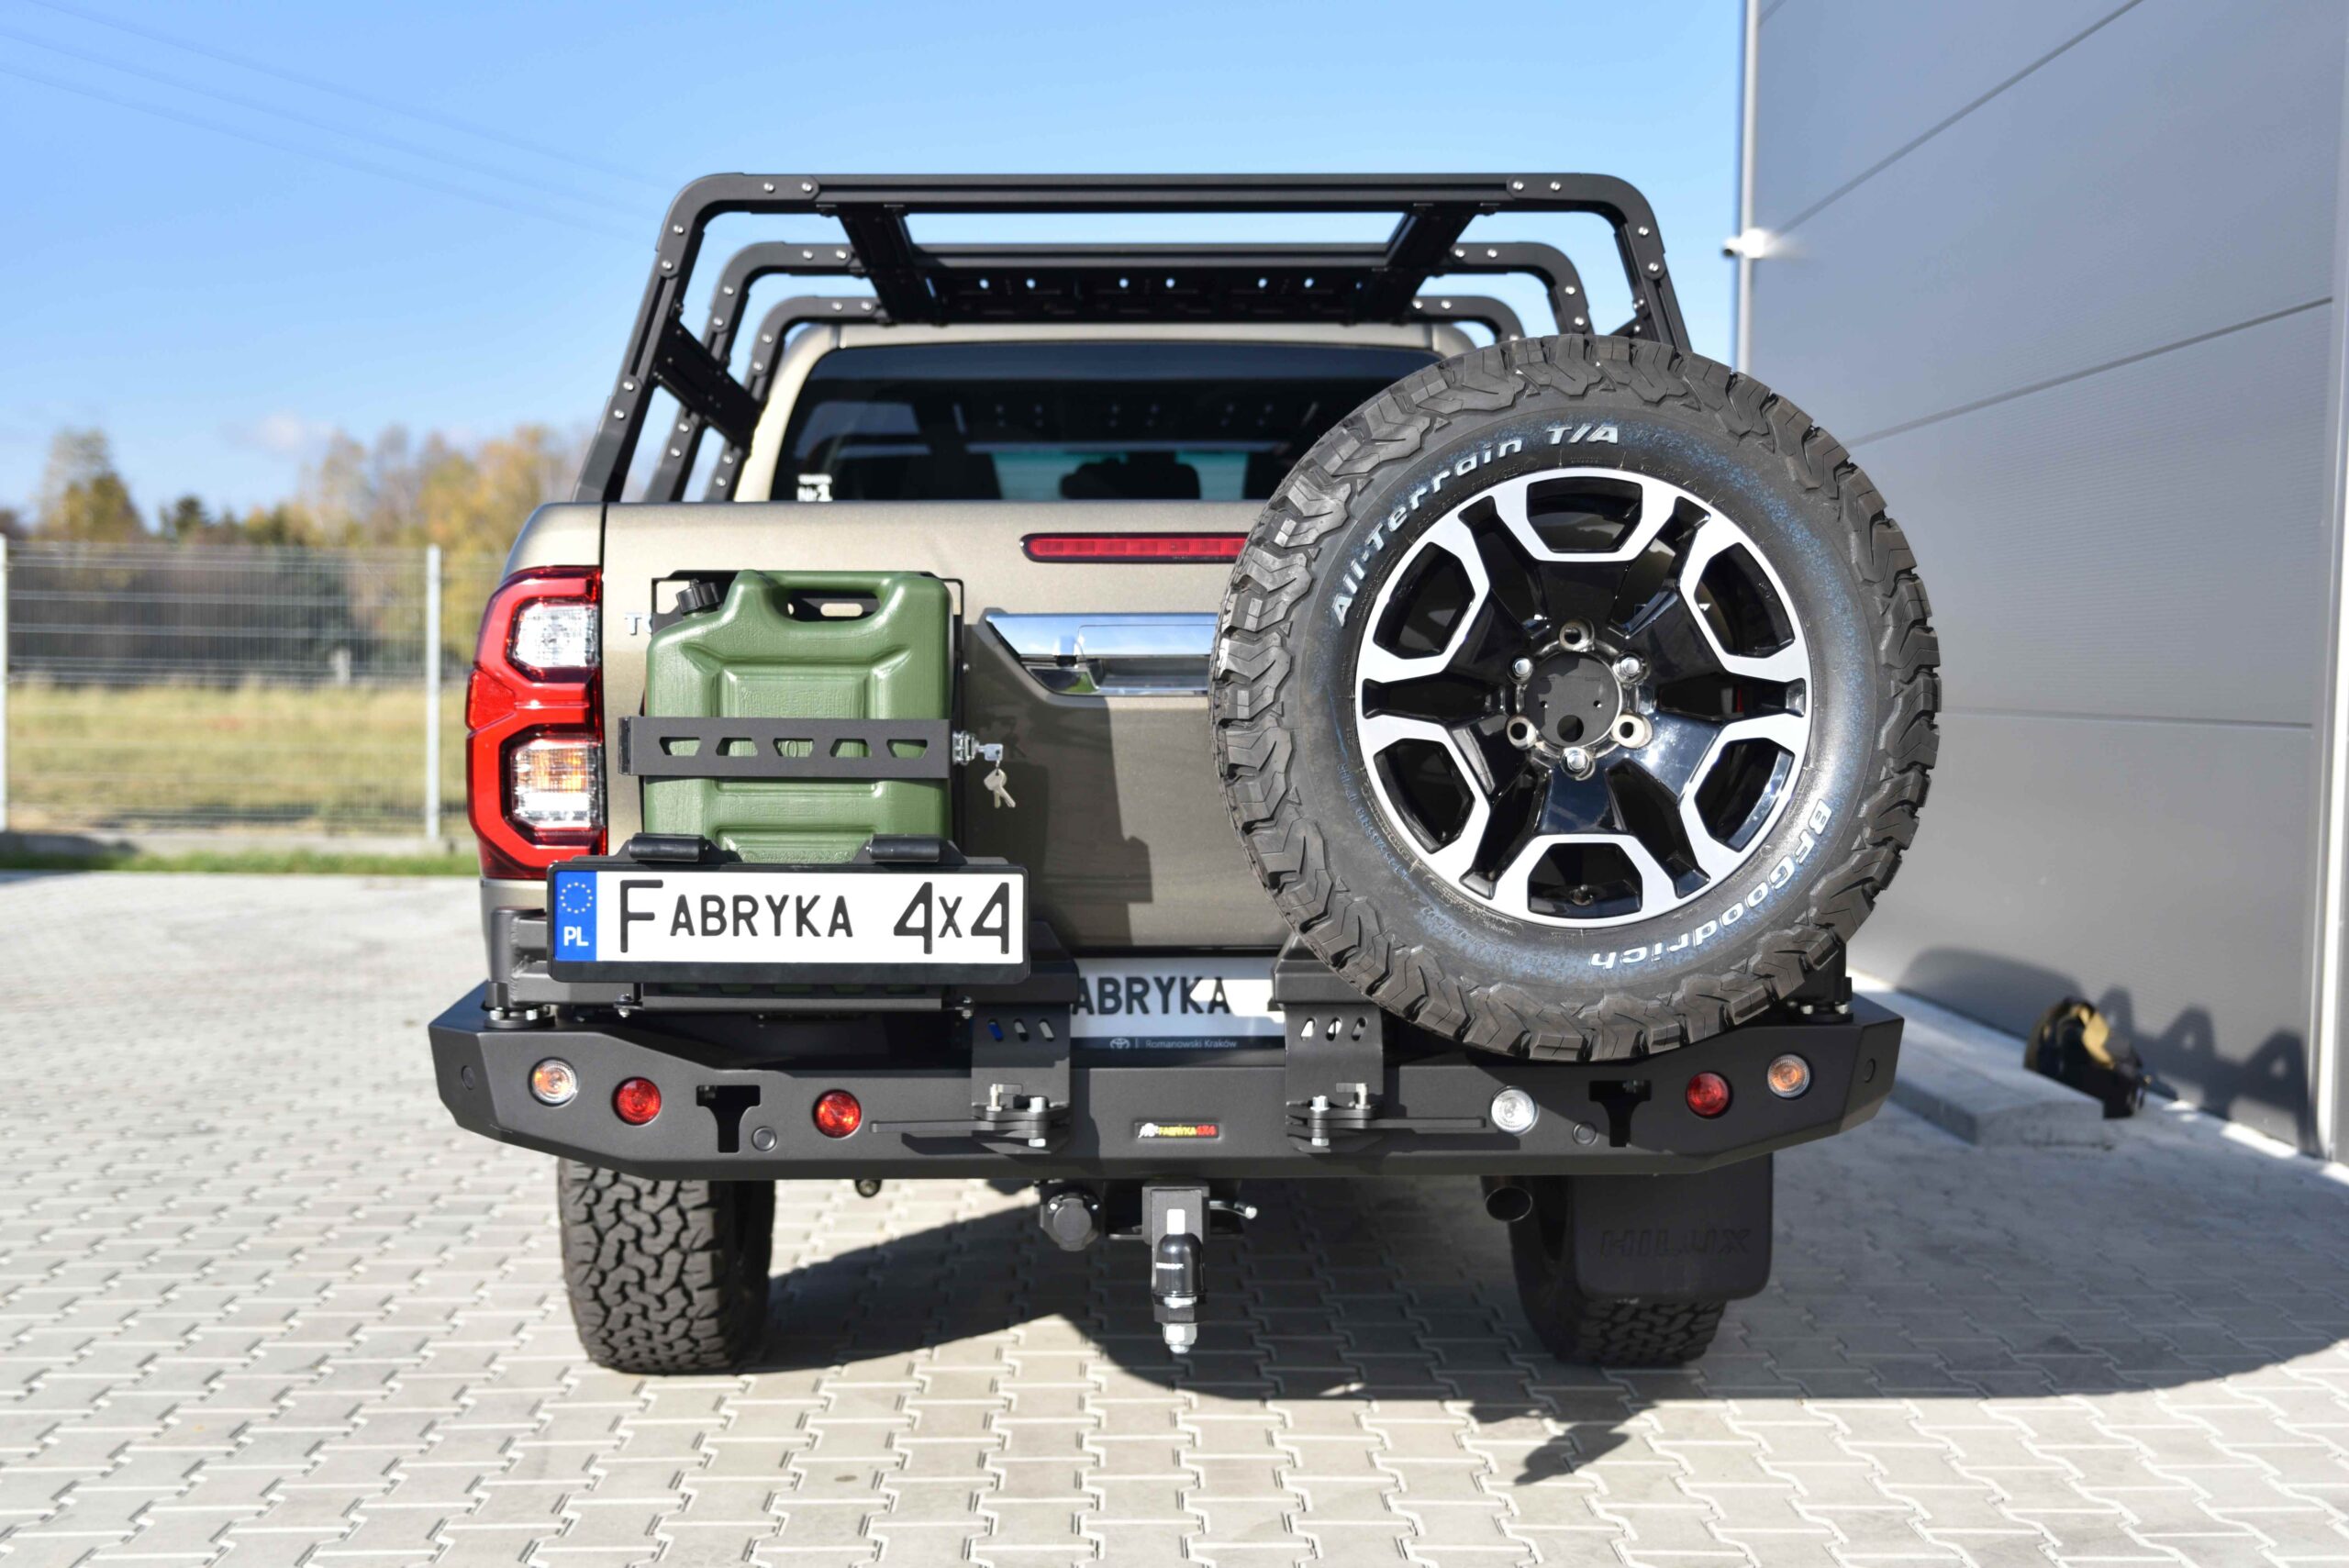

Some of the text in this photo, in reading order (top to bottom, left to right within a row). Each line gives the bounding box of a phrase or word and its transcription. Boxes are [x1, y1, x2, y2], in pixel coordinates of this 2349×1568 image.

[1330, 423, 1620, 628] All-Terrain T/A
[563, 926, 589, 946] PL
[619, 879, 853, 953] FABRYKA
[1587, 798, 1832, 970] BFGoodrich
